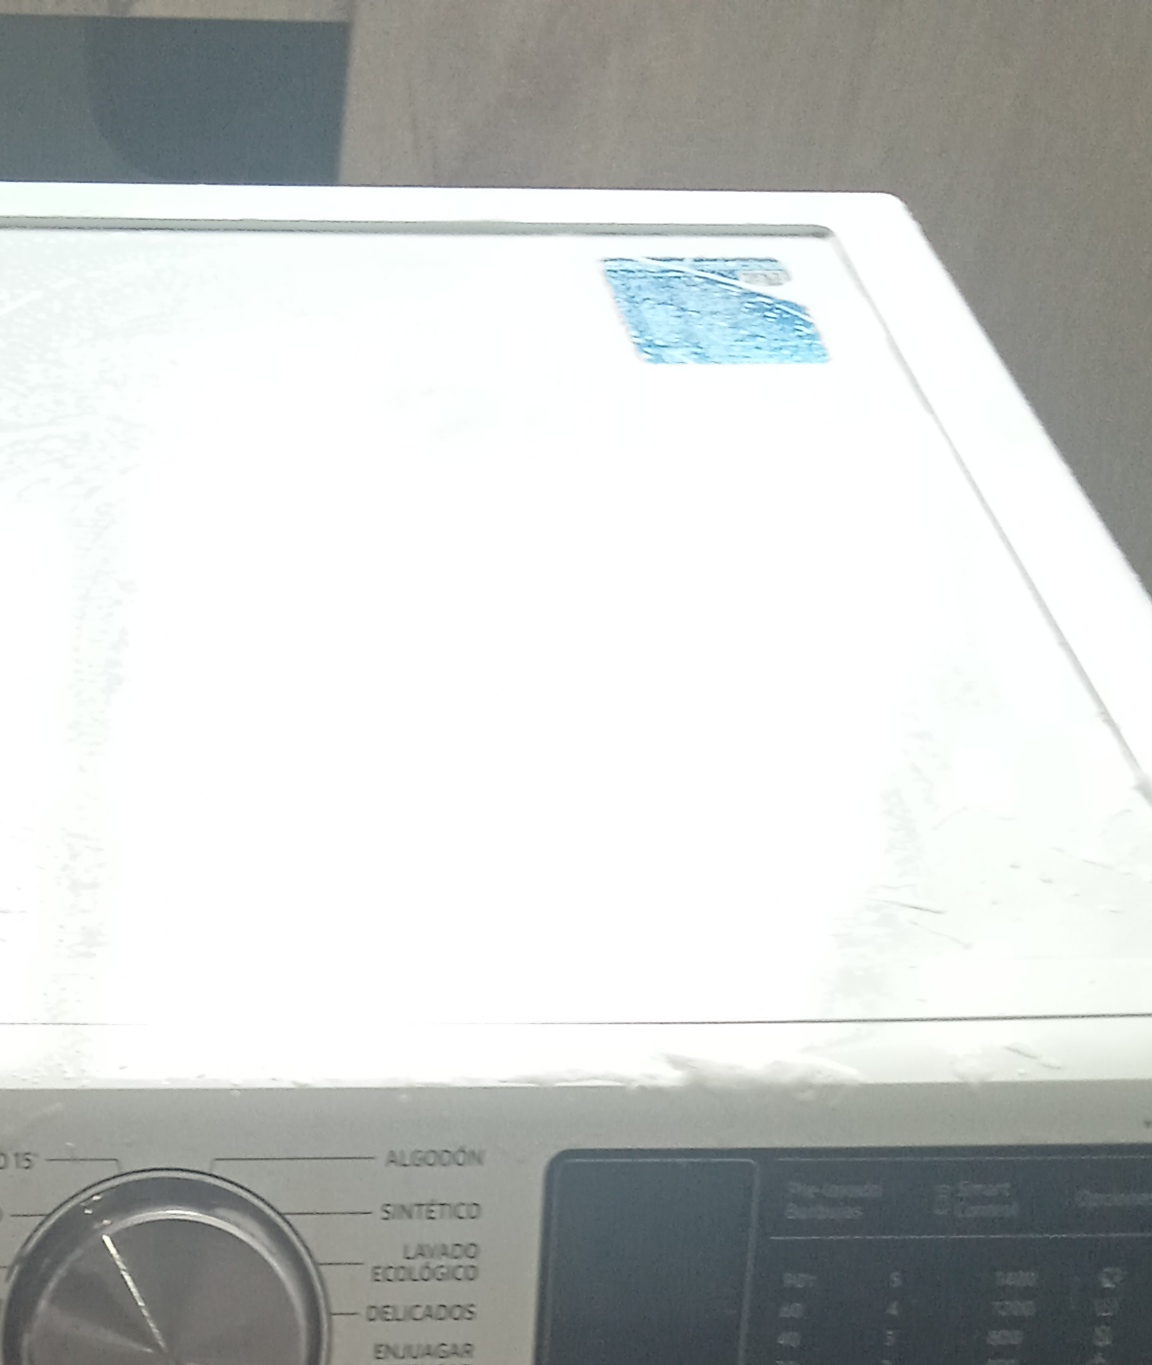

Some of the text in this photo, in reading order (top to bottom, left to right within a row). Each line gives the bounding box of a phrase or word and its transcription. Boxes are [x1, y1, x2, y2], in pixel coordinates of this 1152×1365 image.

[384, 1145, 485, 1167] ALGODÓN
[380, 1200, 482, 1221] SINTÉTICO
[402, 1242, 481, 1260] LAVADO
[371, 1262, 480, 1282] ECOLÓGICO
[366, 1303, 477, 1322] DELICADOS
[373, 1342, 474, 1360] ENJUAGAR
